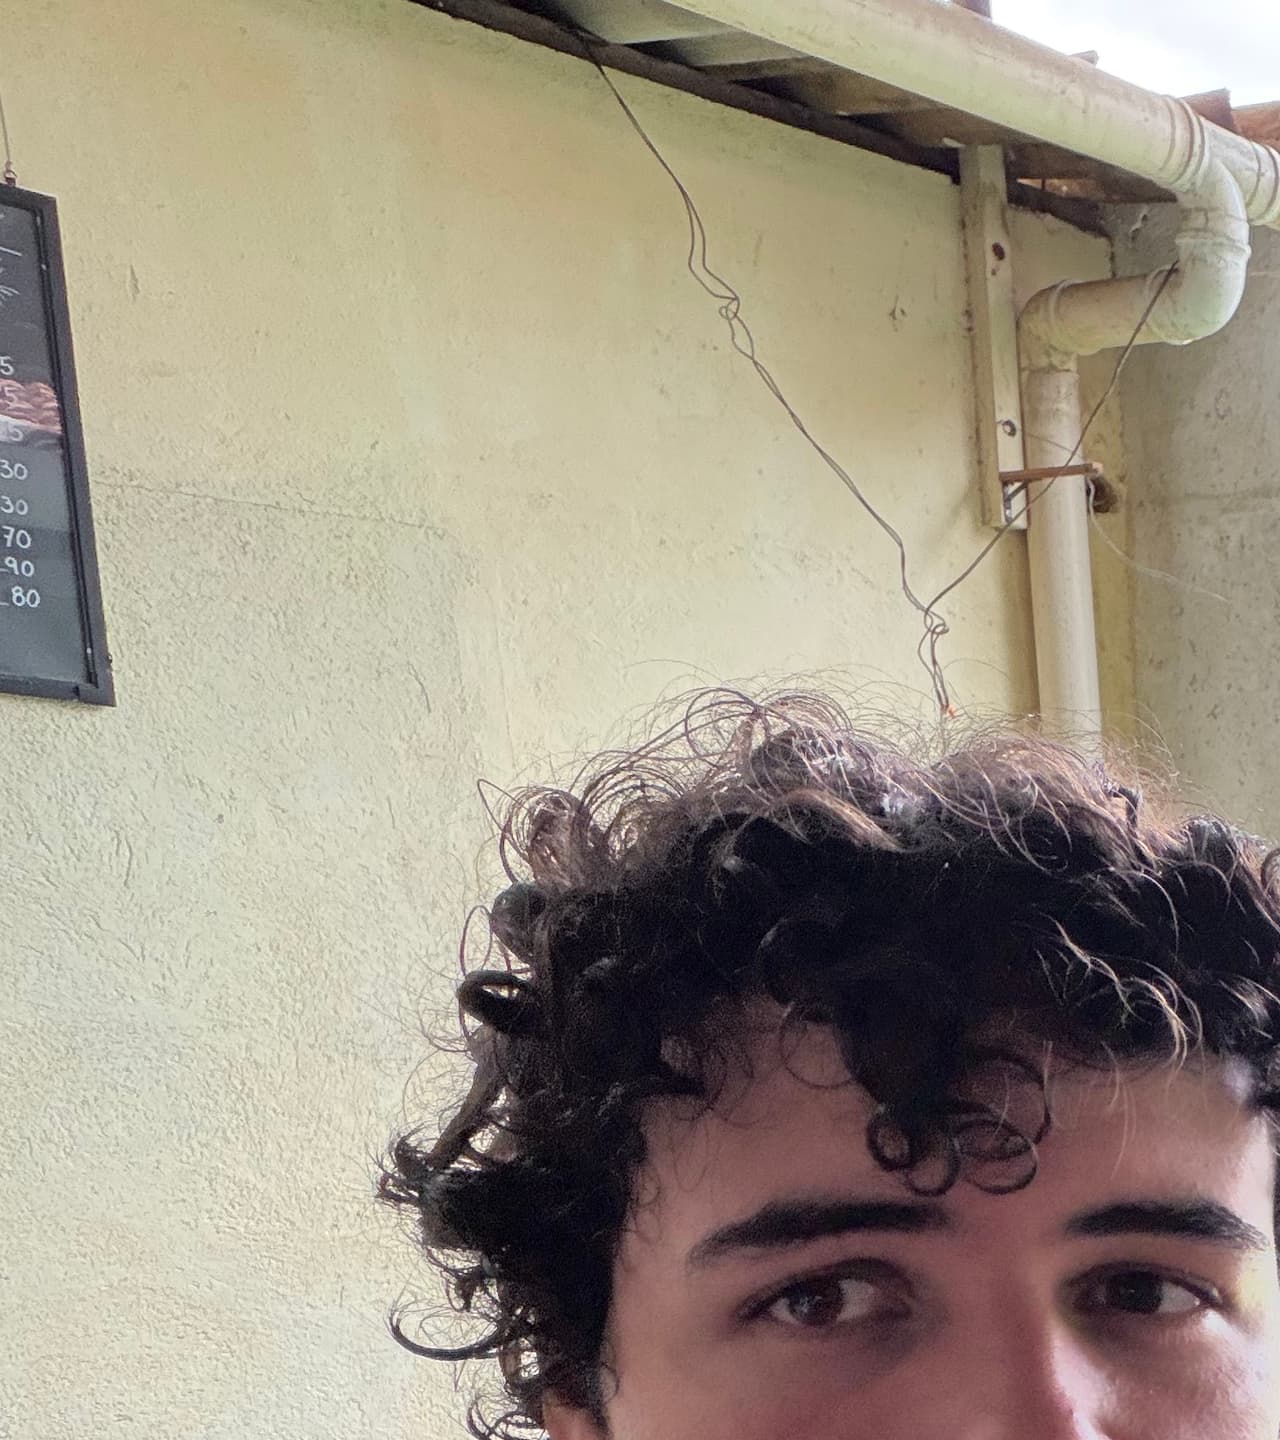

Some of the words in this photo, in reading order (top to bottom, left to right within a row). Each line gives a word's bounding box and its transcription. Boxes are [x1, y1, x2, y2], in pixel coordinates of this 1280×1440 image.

[1, 525, 32, 549] 70
[4, 556, 35, 577] 90
[11, 585, 41, 608] 80
